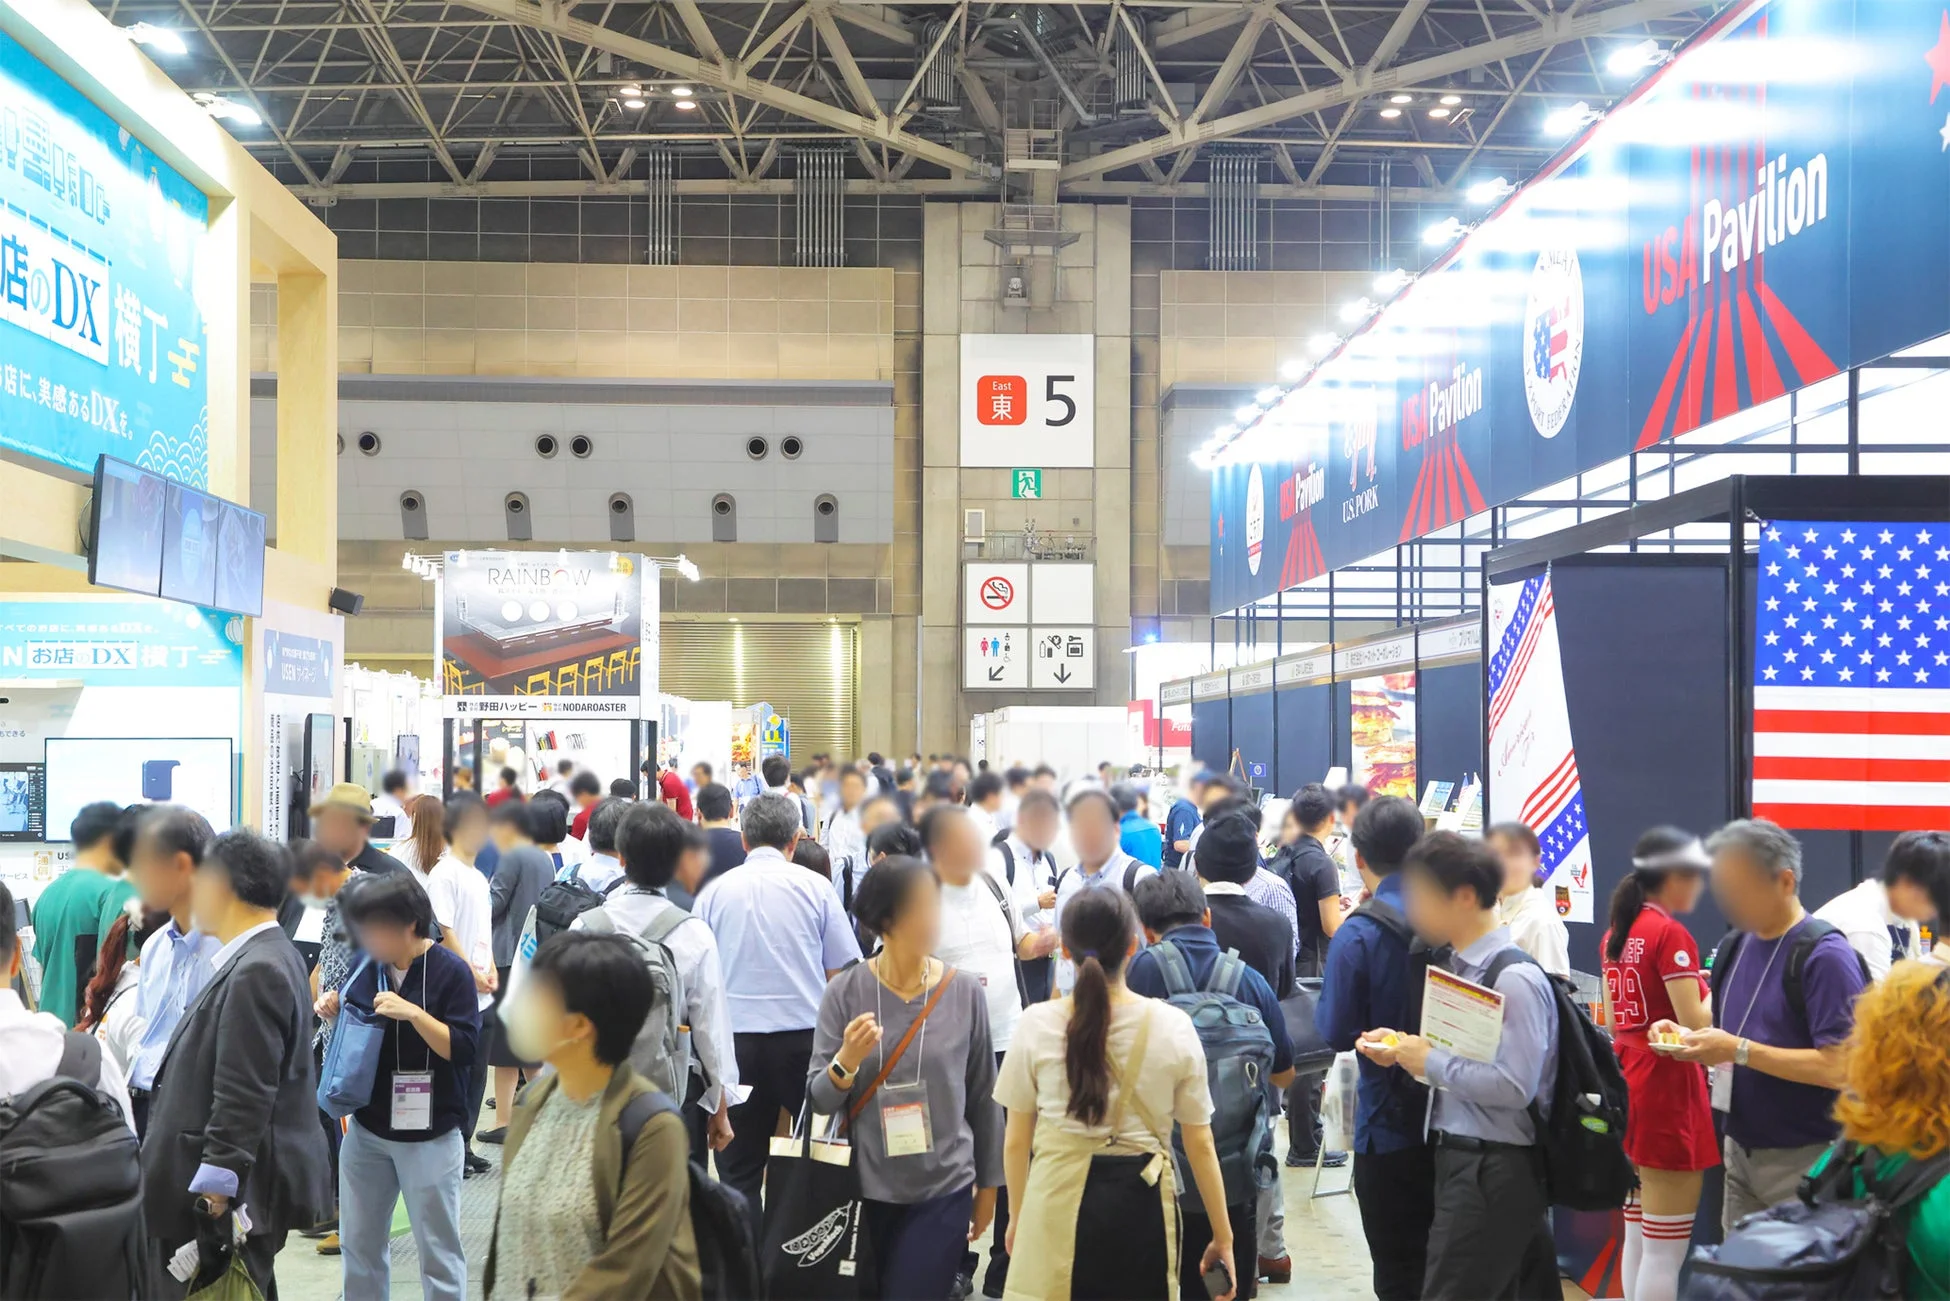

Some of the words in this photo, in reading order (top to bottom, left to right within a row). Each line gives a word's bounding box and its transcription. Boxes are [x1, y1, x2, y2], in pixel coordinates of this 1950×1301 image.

[1642, 214, 1699, 316] USA
[1702, 152, 1828, 285] Pavilion
[113, 282, 169, 385] 横丁
[991, 393, 1013, 421] 東
[1045, 375, 1077, 427] 5
[992, 380, 1012, 391] East
[1402, 387, 1428, 452] USA
[1428, 361, 1483, 437] Pavilion
[1279, 473, 1296, 523] USA
[1295, 462, 1325, 515] Pavilion
[487, 568, 592, 586] RAINBOW
[140, 644, 199, 668] 横丁
[479, 702, 537, 712] 野田ハッピー
[562, 703, 627, 712] NODAROASTER
